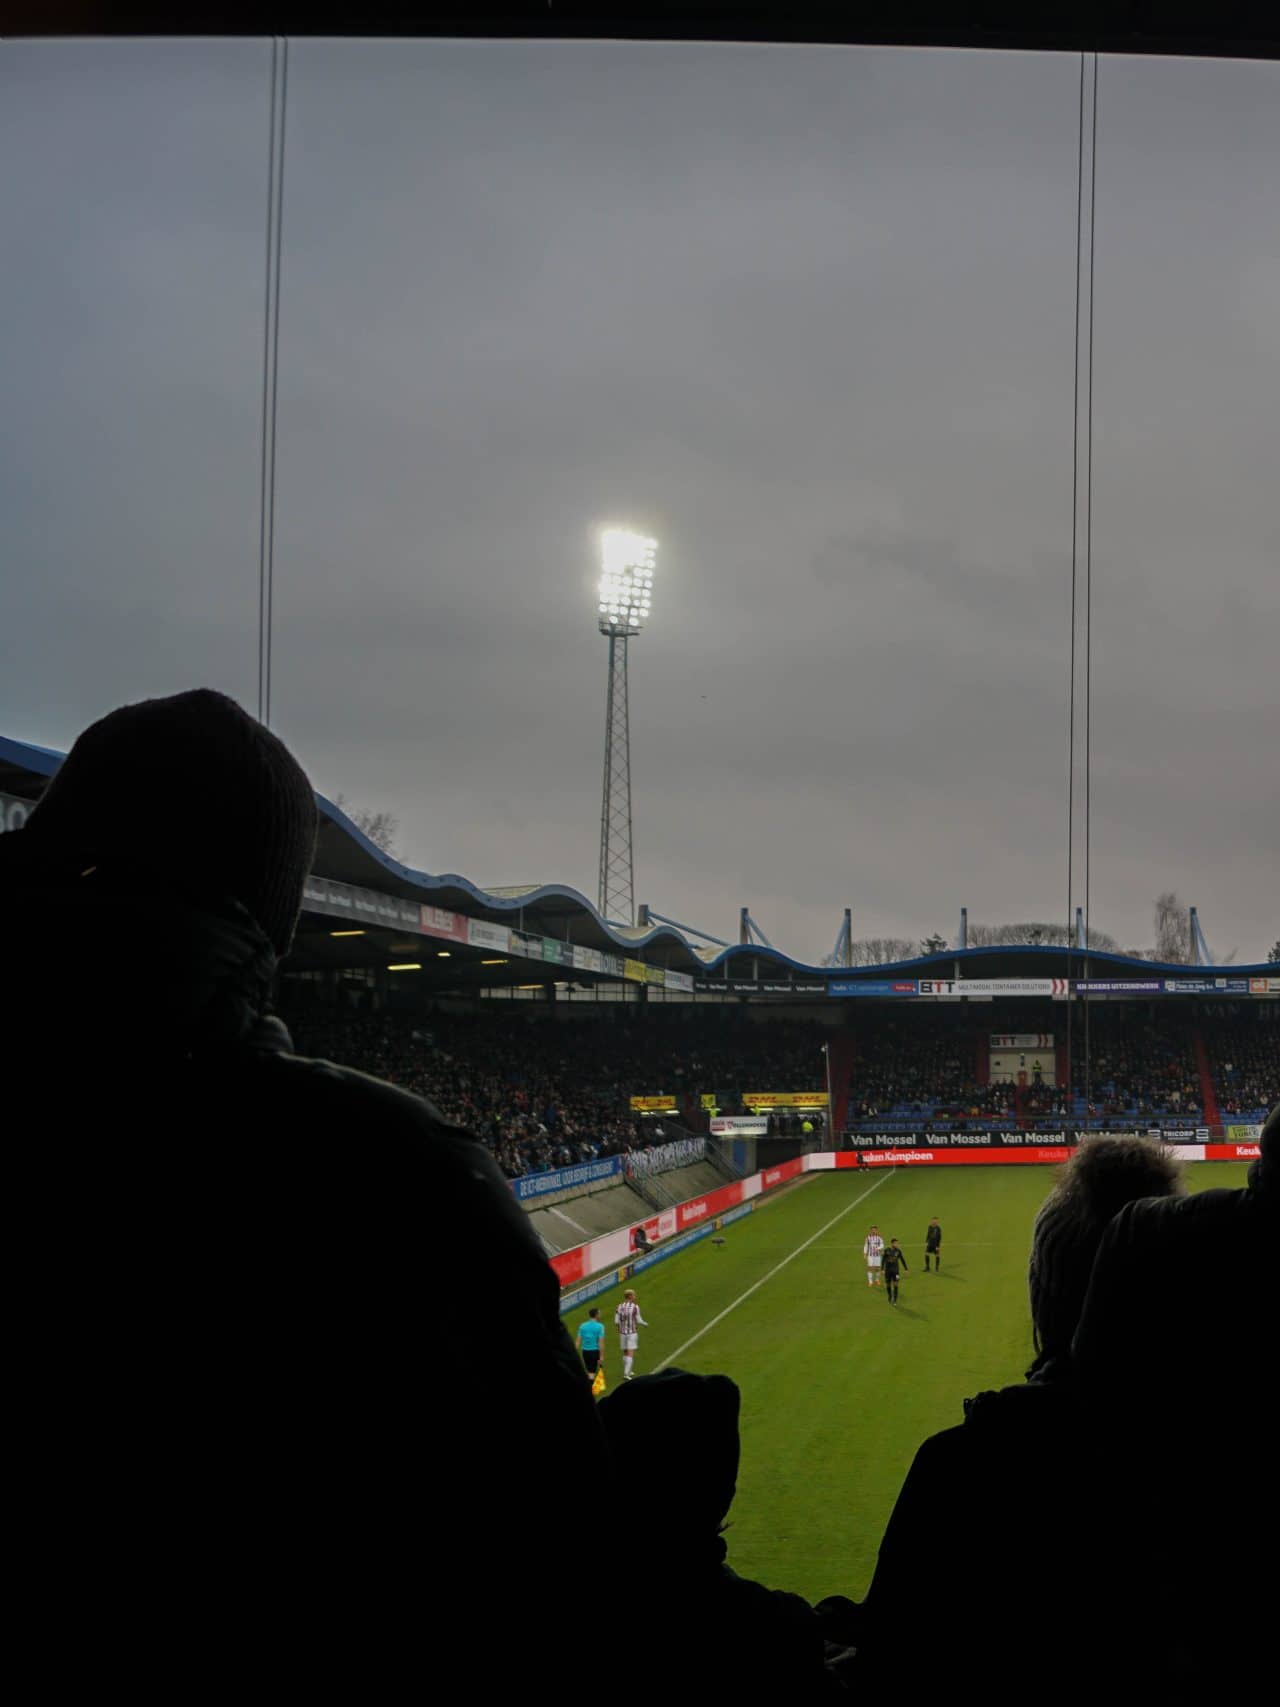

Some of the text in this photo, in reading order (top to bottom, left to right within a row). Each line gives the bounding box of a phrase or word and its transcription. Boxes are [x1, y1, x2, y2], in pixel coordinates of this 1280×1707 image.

[920, 981, 956, 993] BTT
[851, 1133, 917, 1146] Van Mossel
[925, 1132, 991, 1144] Van Mossel
[1000, 1132, 1023, 1143] Van
[1025, 1131, 1065, 1143] Mossel
[884, 1151, 933, 1164] Kampioen
